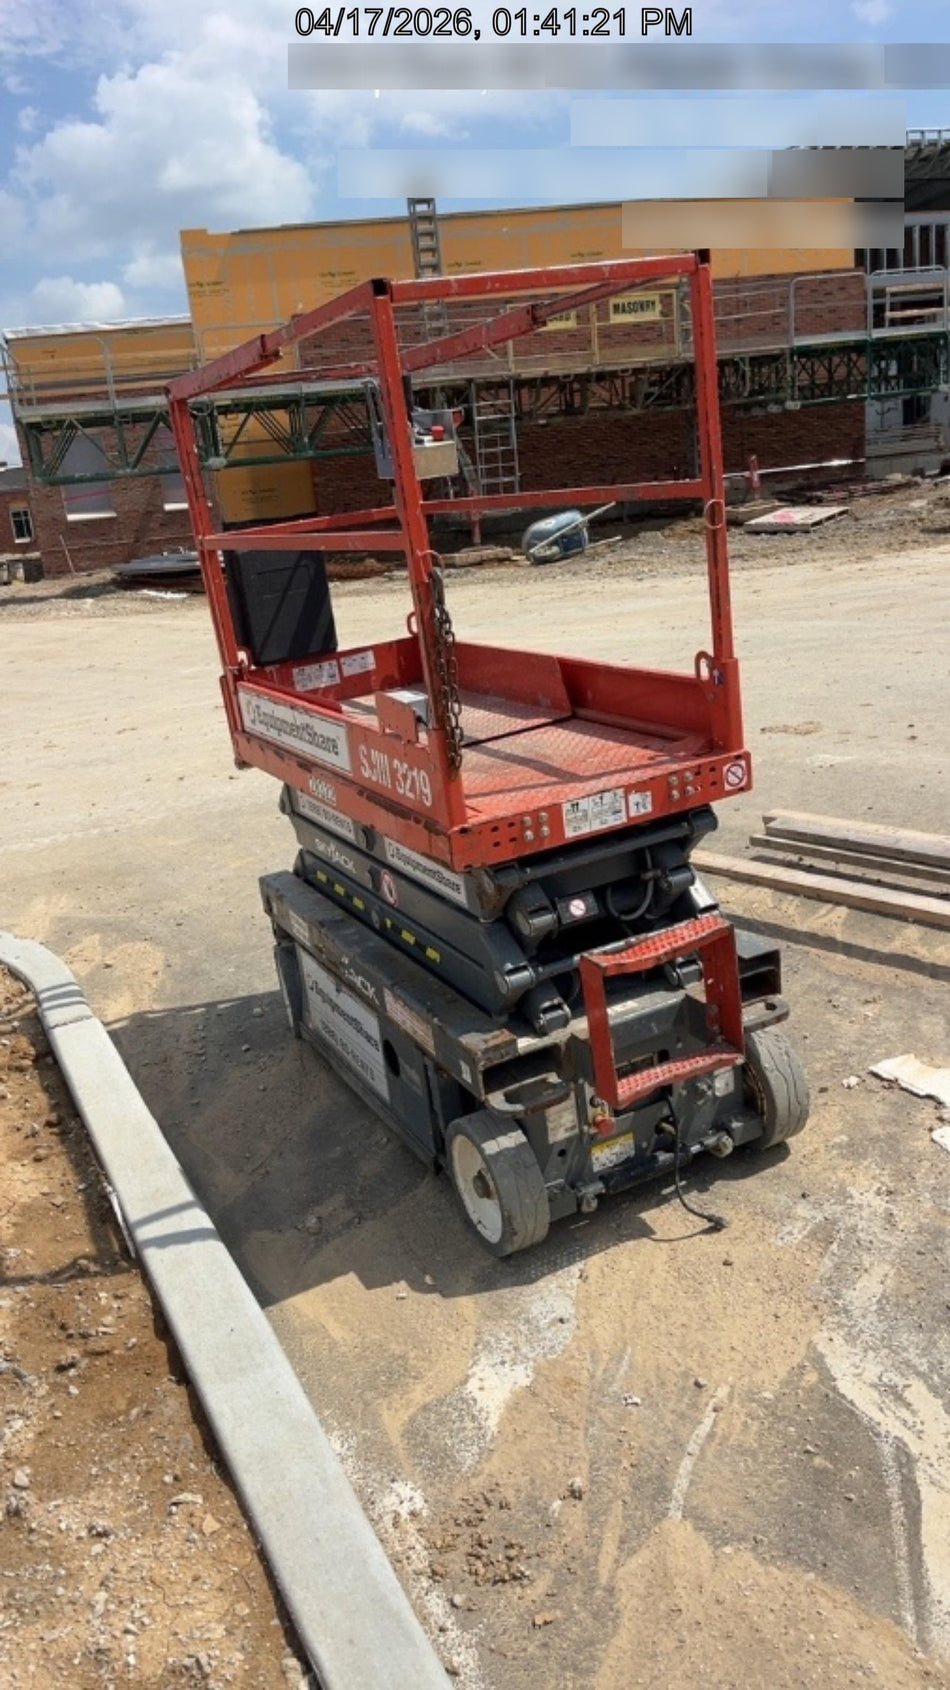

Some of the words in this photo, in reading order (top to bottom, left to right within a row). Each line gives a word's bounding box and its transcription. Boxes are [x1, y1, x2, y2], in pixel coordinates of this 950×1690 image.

[612, 299, 657, 315] MASONRY
[254, 703, 340, 756] EquipmentShare
[393, 759, 433, 807] 3219
